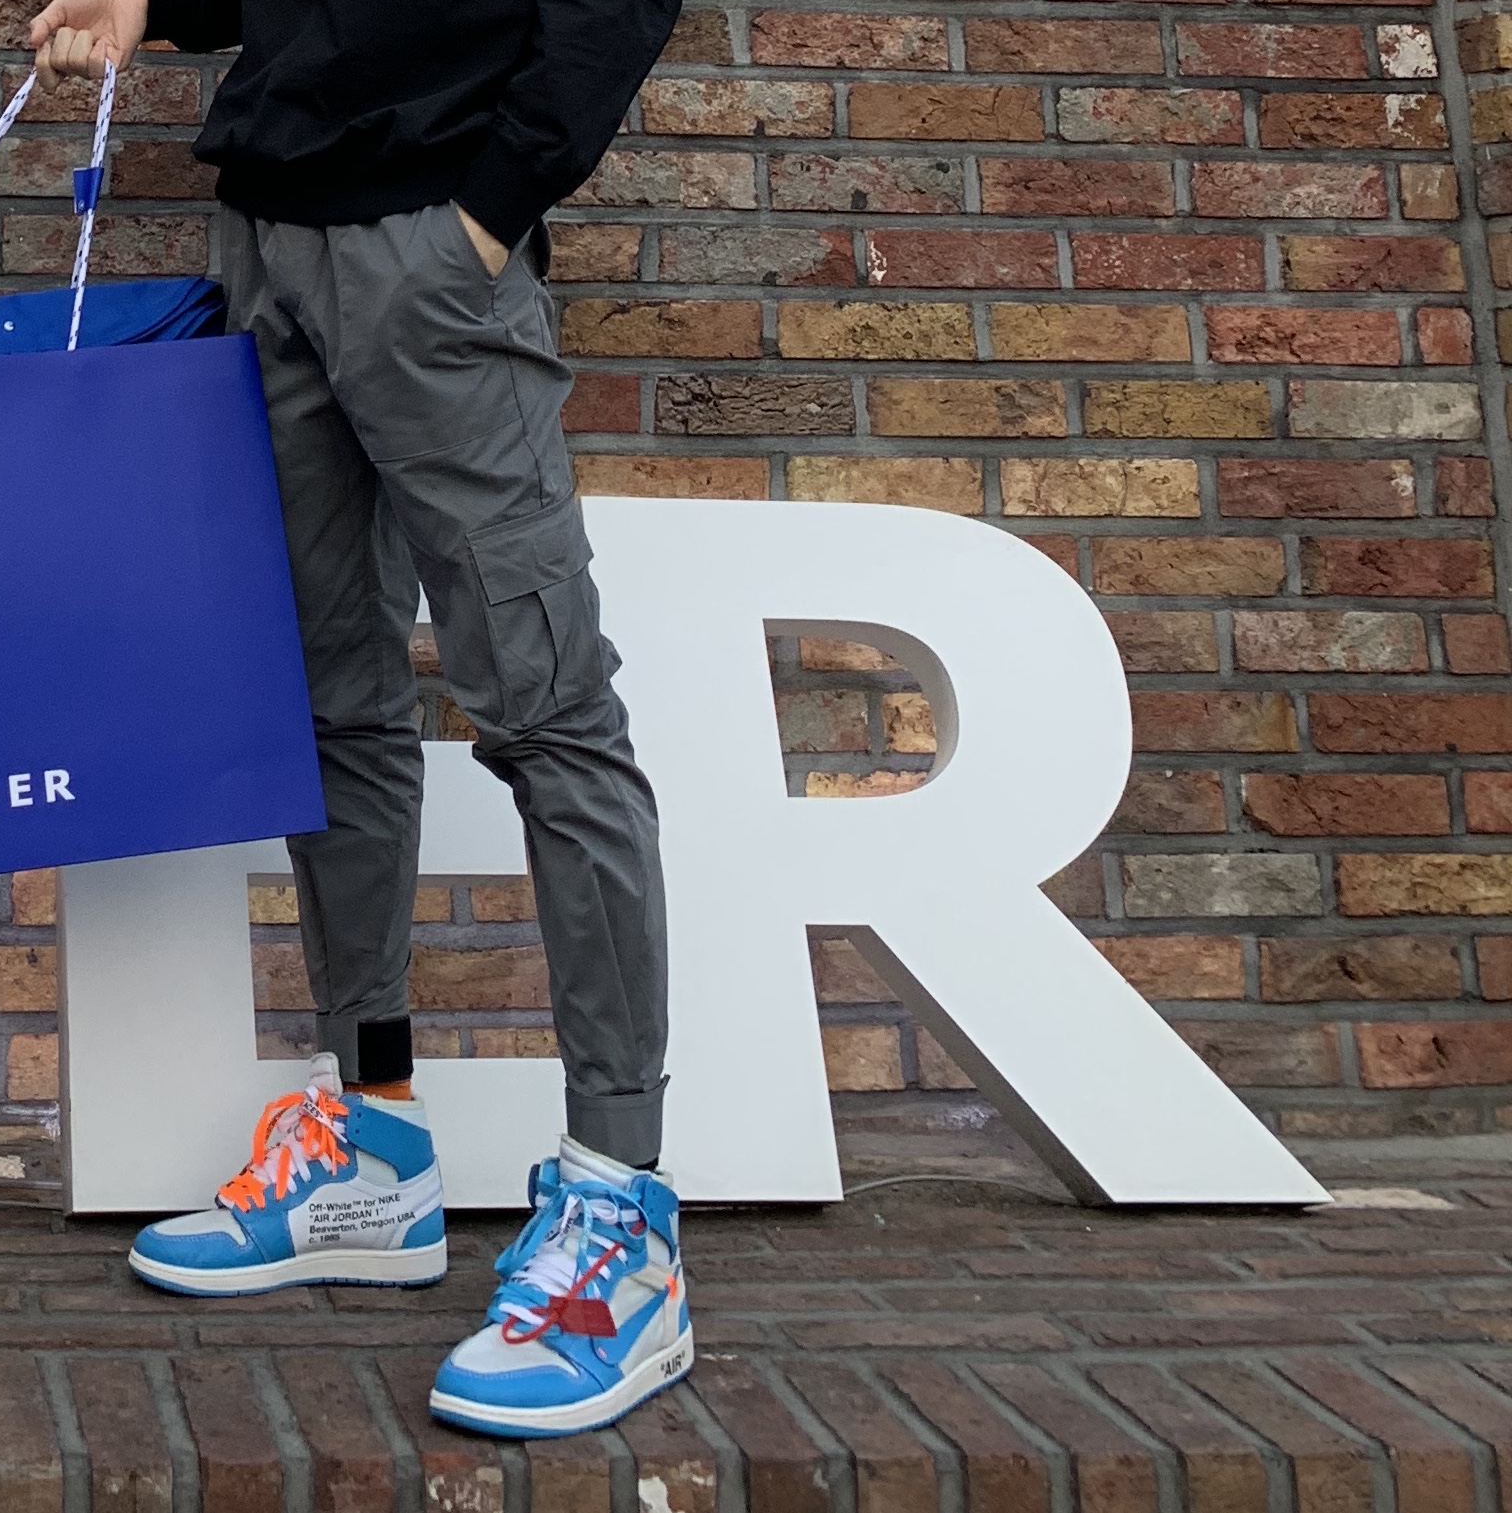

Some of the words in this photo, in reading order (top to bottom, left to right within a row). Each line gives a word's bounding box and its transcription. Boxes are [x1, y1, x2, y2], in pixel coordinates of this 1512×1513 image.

[364, 1199, 376, 1208] for
[379, 1193, 401, 1205] NIKE
[332, 1209, 372, 1222] JORDAN
[361, 1216, 395, 1230] Oregon
